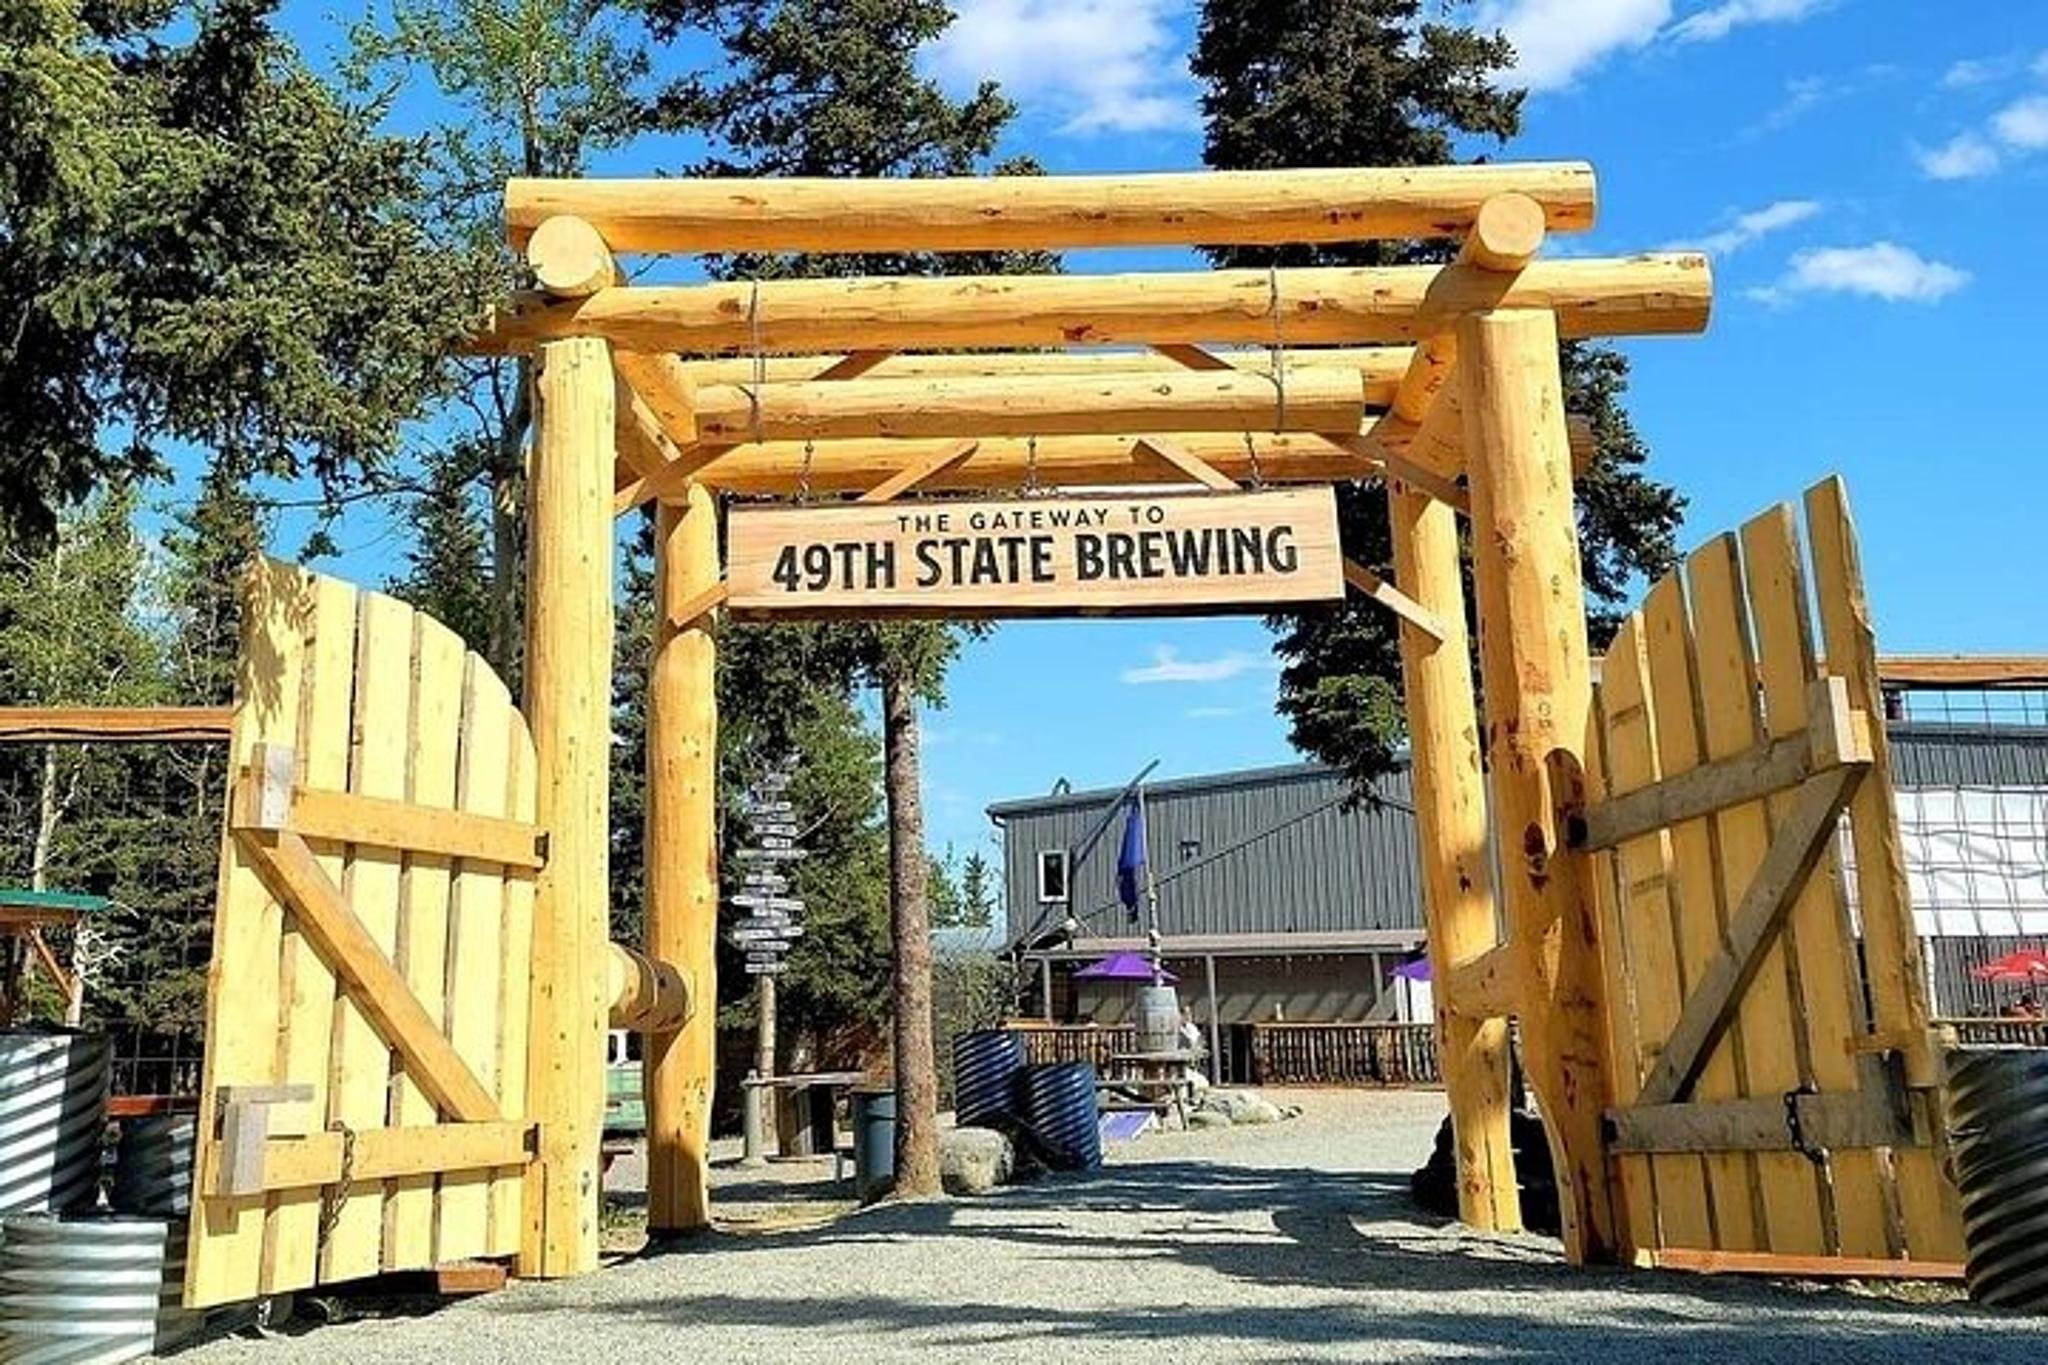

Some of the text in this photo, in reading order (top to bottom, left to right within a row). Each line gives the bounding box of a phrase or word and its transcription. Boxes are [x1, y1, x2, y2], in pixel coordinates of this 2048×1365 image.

[897, 505, 1164, 533] THE GATEWAY TO
[772, 525, 1298, 593] 49TH STATE BREWING
